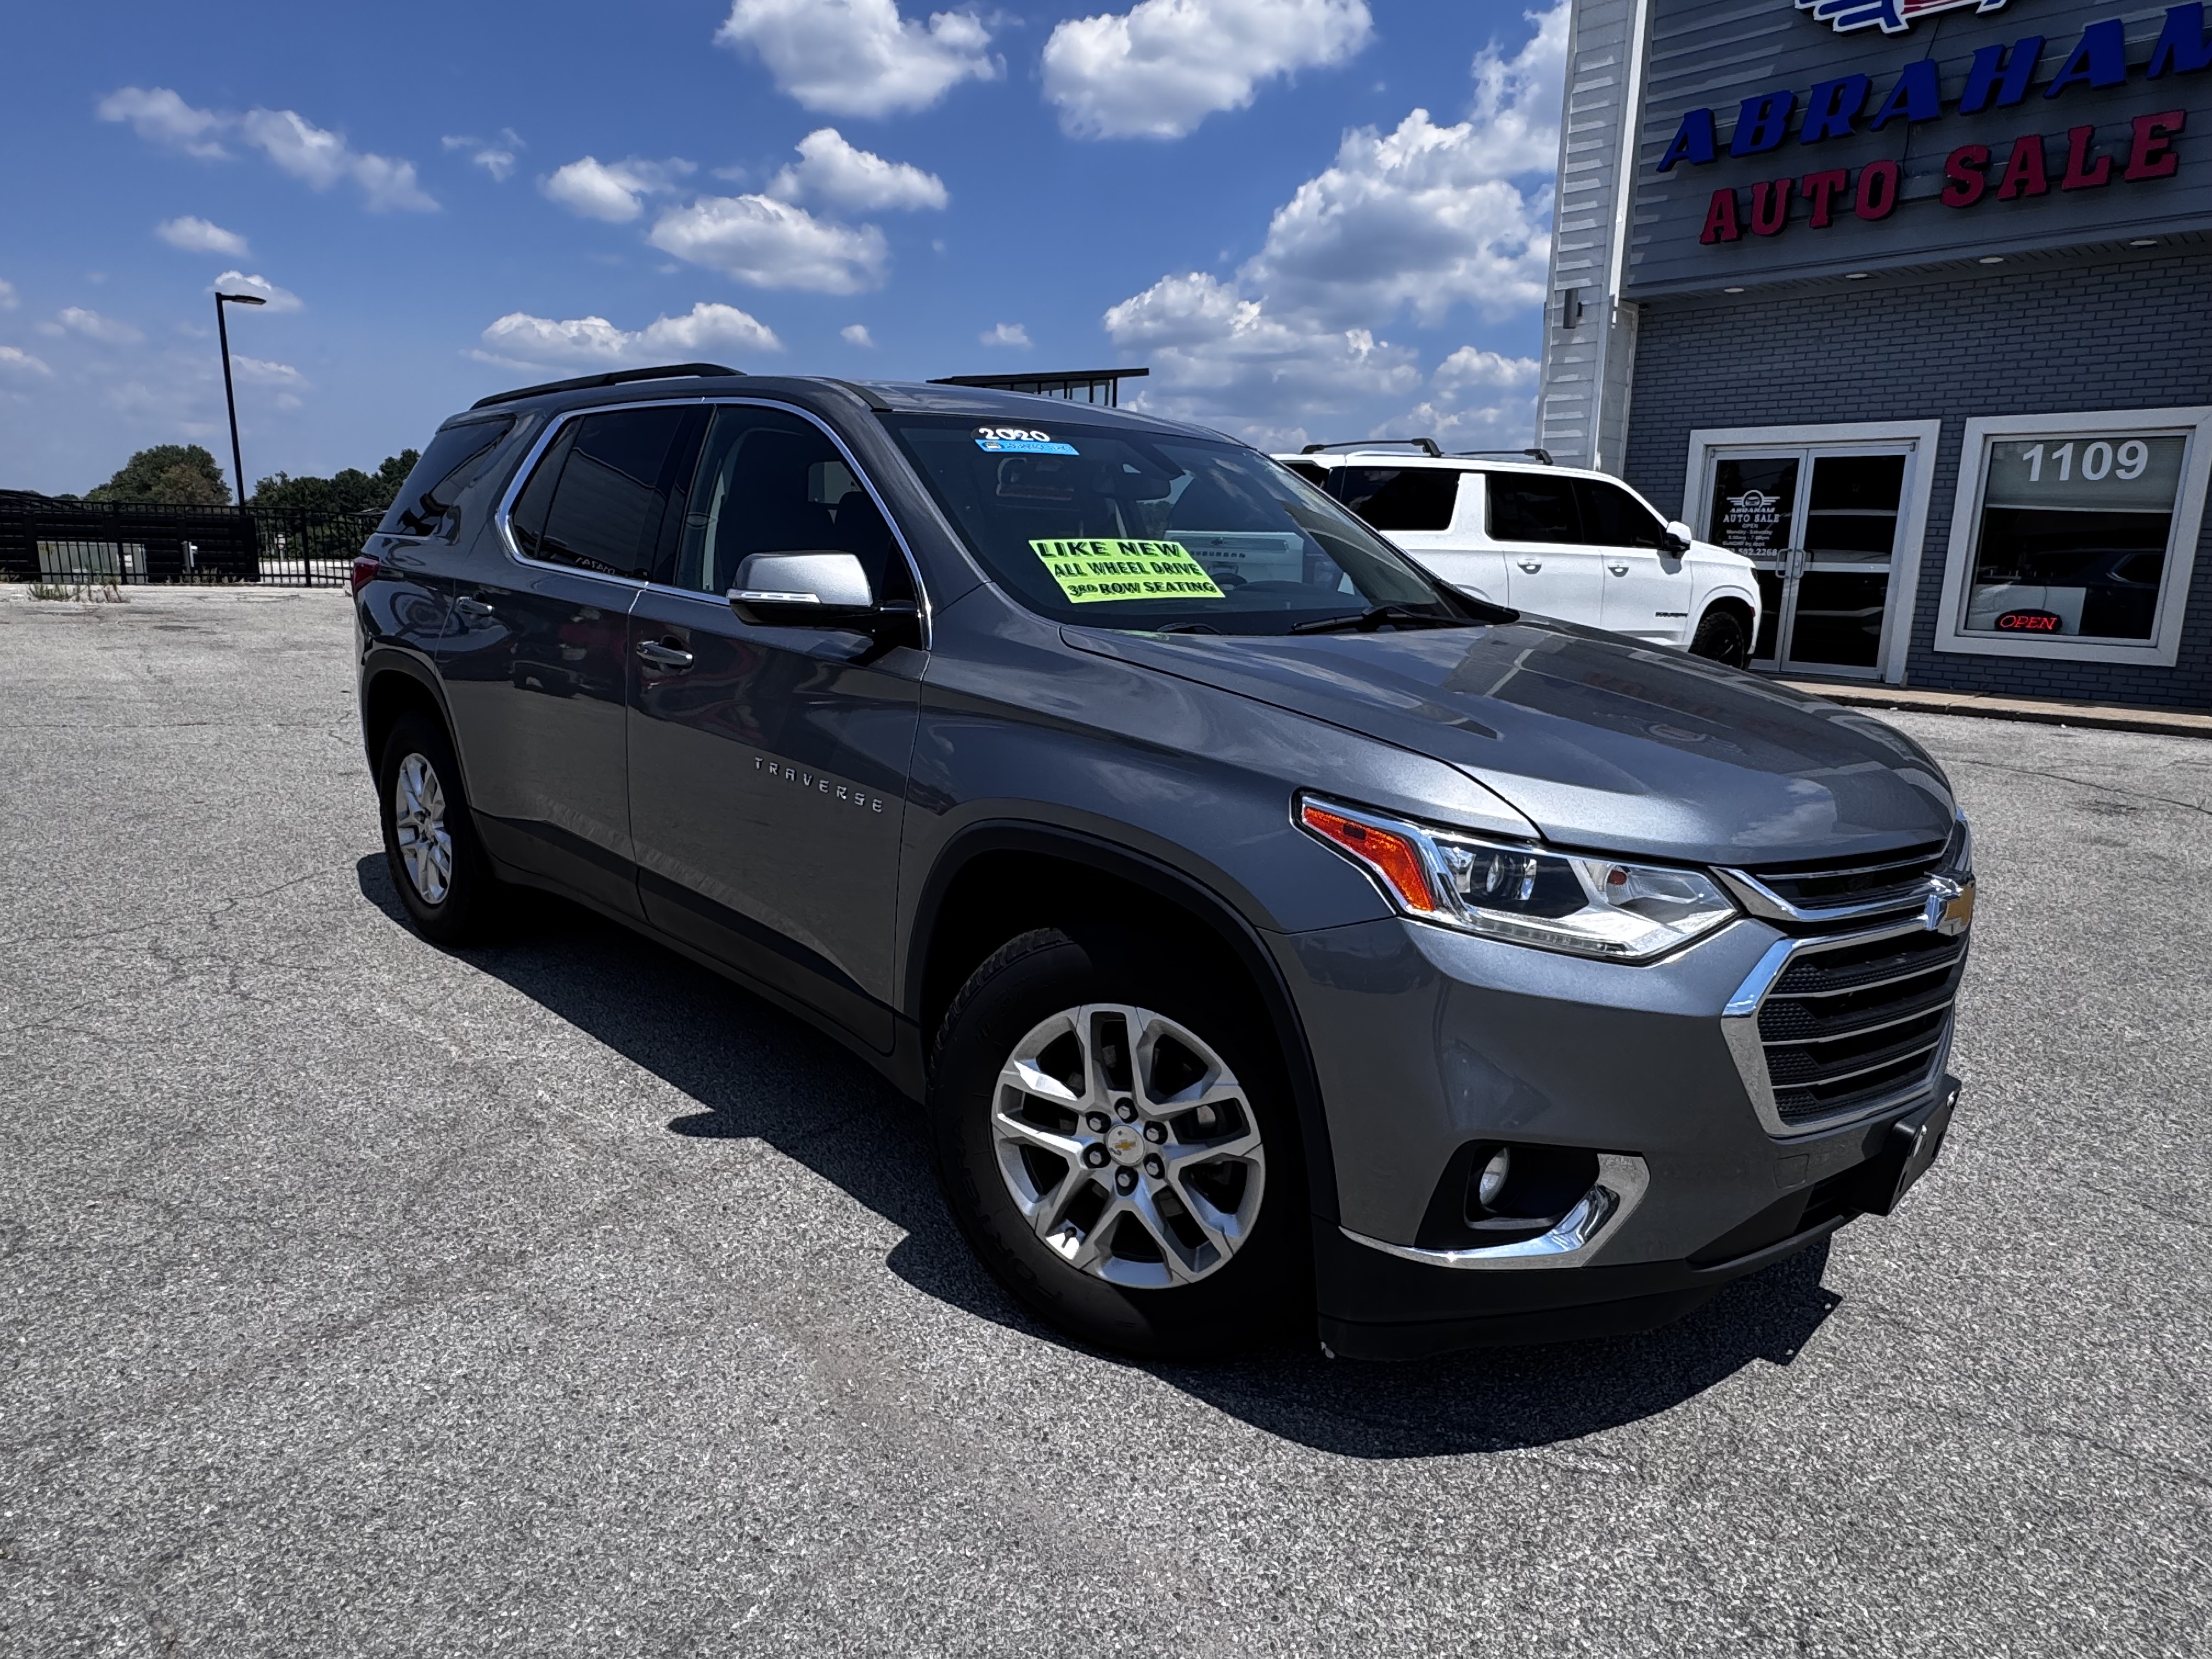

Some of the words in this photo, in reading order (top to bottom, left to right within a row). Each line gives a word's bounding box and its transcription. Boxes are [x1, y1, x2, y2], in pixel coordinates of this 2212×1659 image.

[1656, 1, 2212, 172] ABRAHAM
[1700, 160, 1900, 245] AUTO
[1941, 110, 2186, 208] SALE
[979, 428, 1050, 442] 2020
[2022, 440, 2148, 482] 1109
[1723, 514, 1750, 523] AUTO
[1754, 514, 1780, 522] SALE
[1036, 541, 1111, 558] LIKE
[1116, 541, 1182, 558] NEW
[1053, 563, 1088, 577] ALL
[1086, 562, 1151, 576] WHEEL
[1149, 562, 1204, 576] DRIVE
[1098, 582, 1142, 595] ROW
[1143, 582, 1217, 594] SEATING
[2000, 615, 2057, 630] OPEN
[754, 757, 883, 813] TRAVERSE
